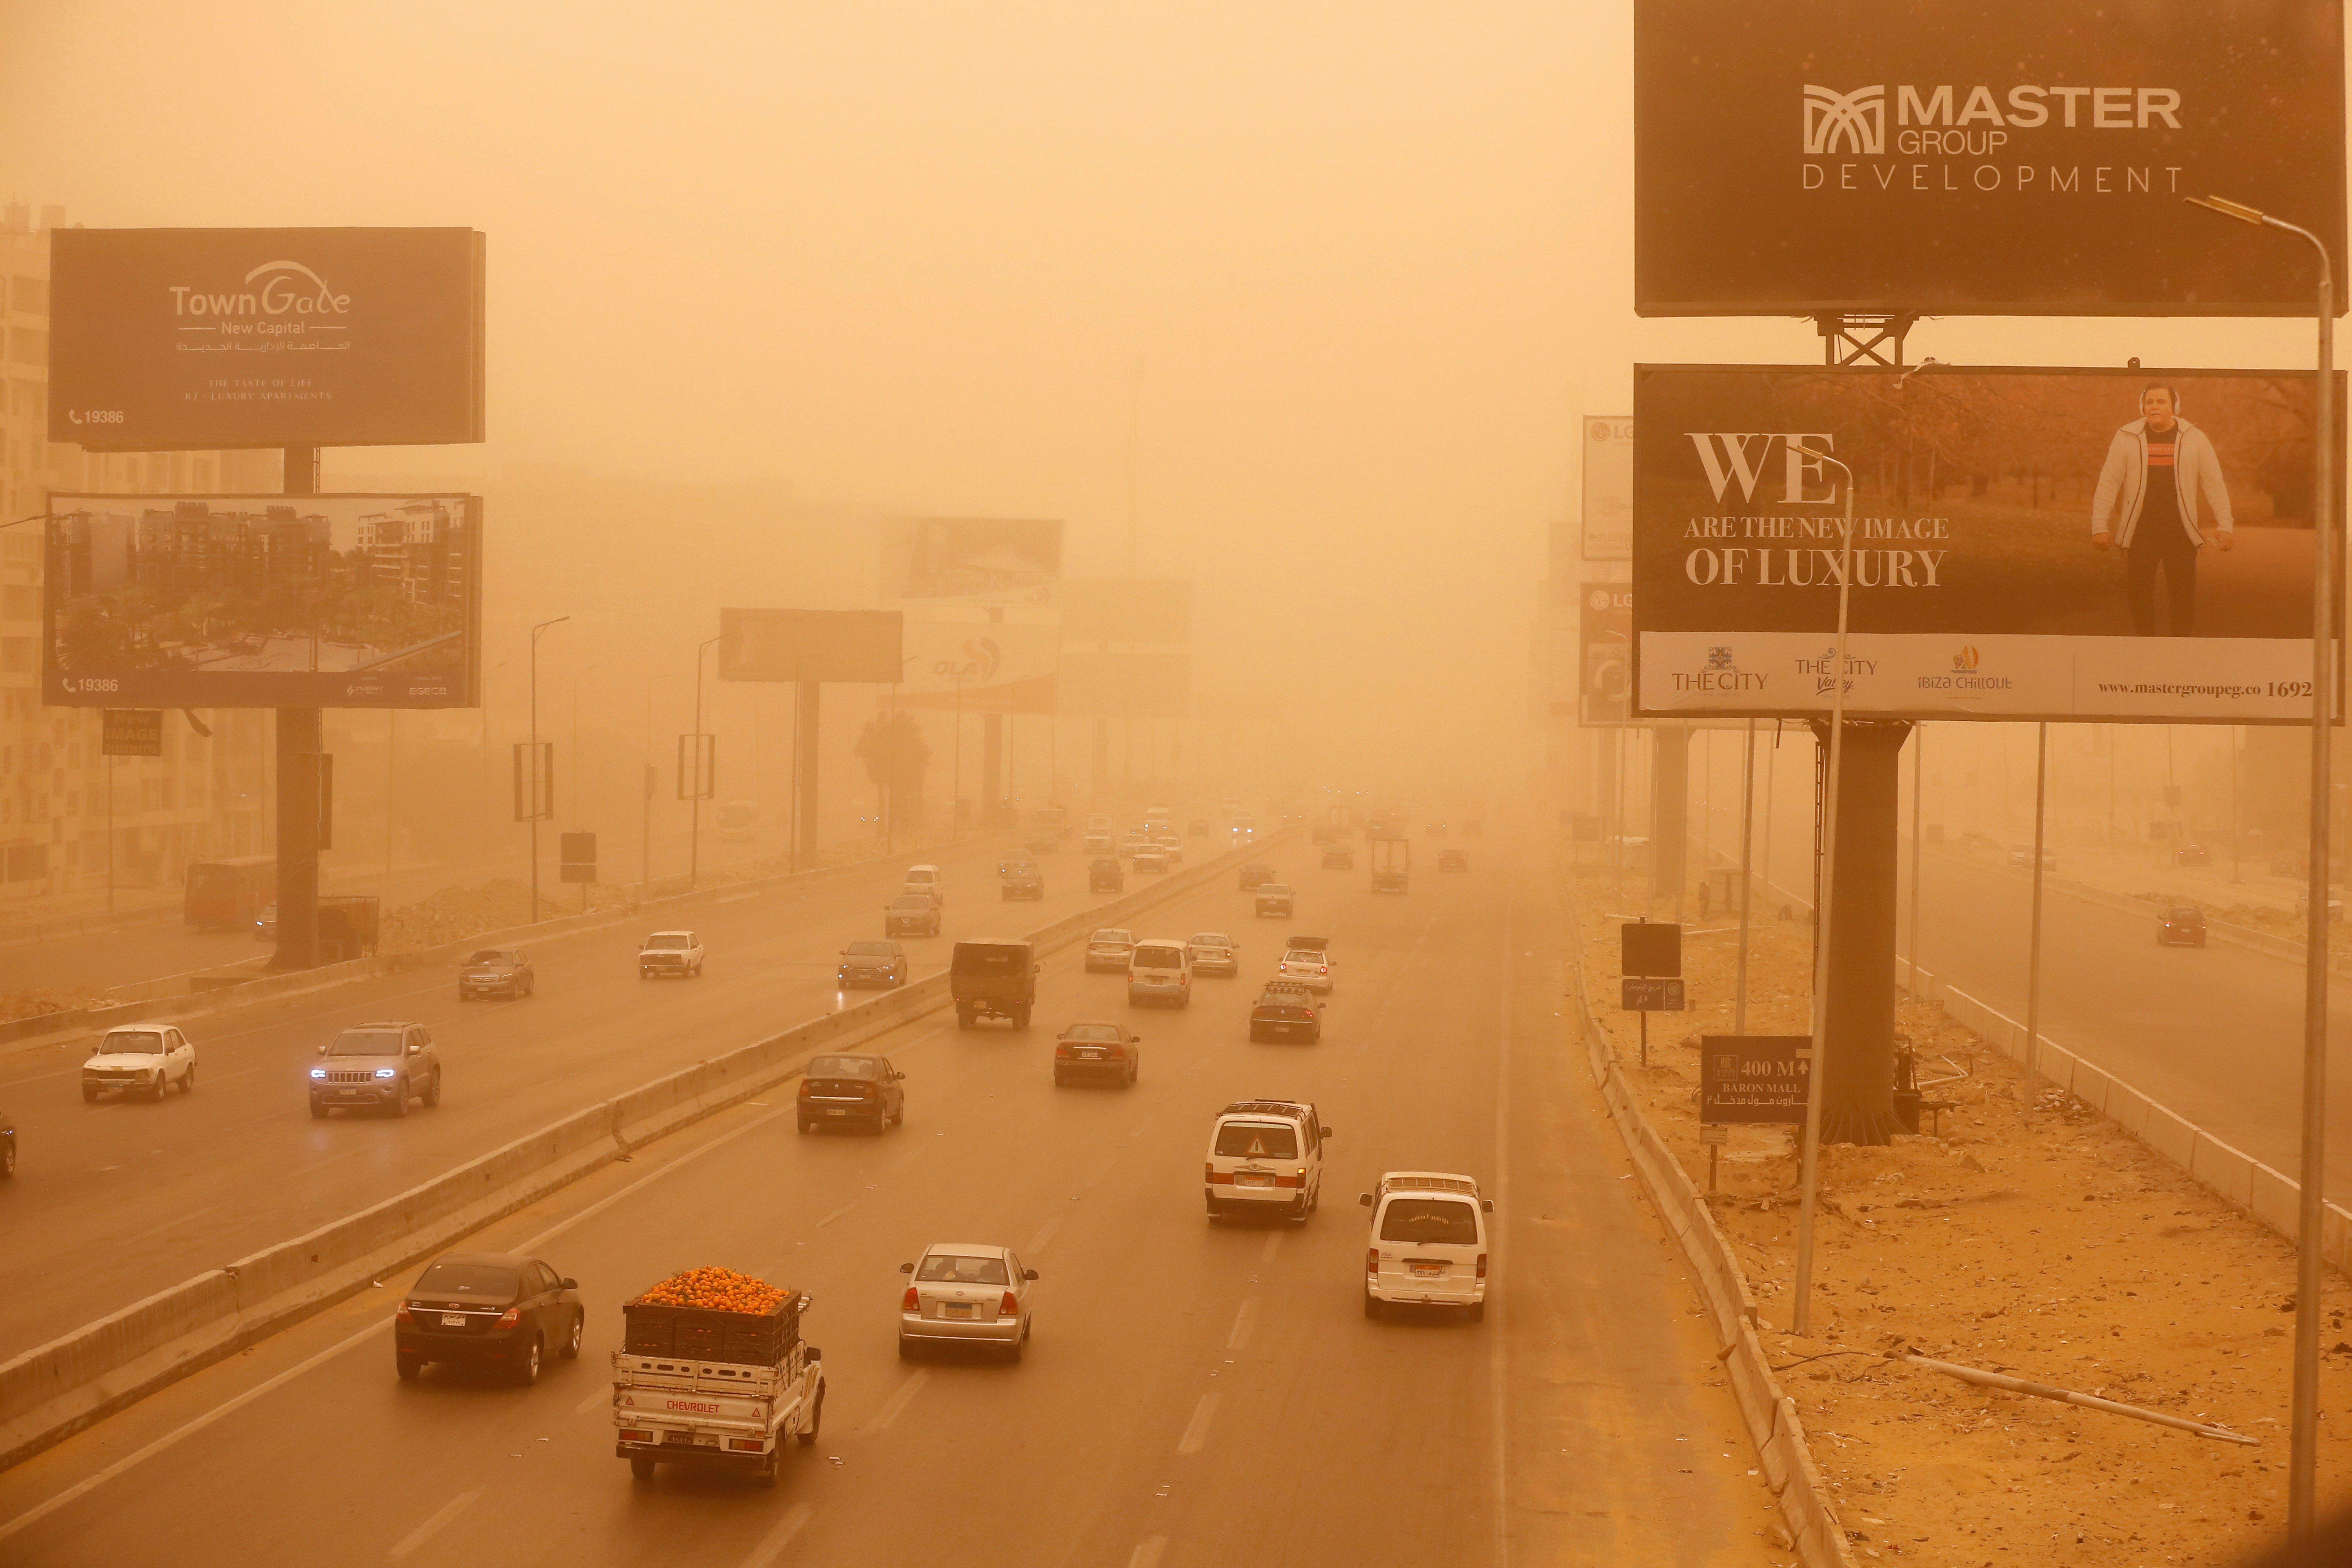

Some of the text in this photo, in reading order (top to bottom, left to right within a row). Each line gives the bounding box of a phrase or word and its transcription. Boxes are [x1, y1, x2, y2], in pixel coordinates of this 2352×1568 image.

[1898, 85, 2183, 129] MASTER
[1898, 130, 2007, 155] GROUP
[1803, 164, 2181, 194] DEVELOPMENT
[169, 276, 350, 315] Town Gate
[221, 321, 305, 336] New Capital
[260, 392, 332, 400] APARTMENTS
[85, 410, 124, 423] 19386
[1614, 425, 1633, 439] LG
[1684, 433, 1835, 504] WE
[1684, 517, 1949, 539] ARE THE NEW IMAGE
[1686, 548, 1949, 587] OF LUXURY
[1613, 593, 1633, 607] LG
[933, 661, 980, 675] OLA
[1795, 660, 1831, 674] THE
[78, 679, 118, 692] 19386
[1672, 673, 1769, 690] THE CITY
[2098, 683, 2261, 699] www.mastergroupeg.co
[105, 728, 158, 741] IMAGE
[1741, 1061, 1795, 1076] 400 M
[1723, 1083, 1800, 1093] BARON MALL
[667, 1400, 720, 1413] CHEVROLET
